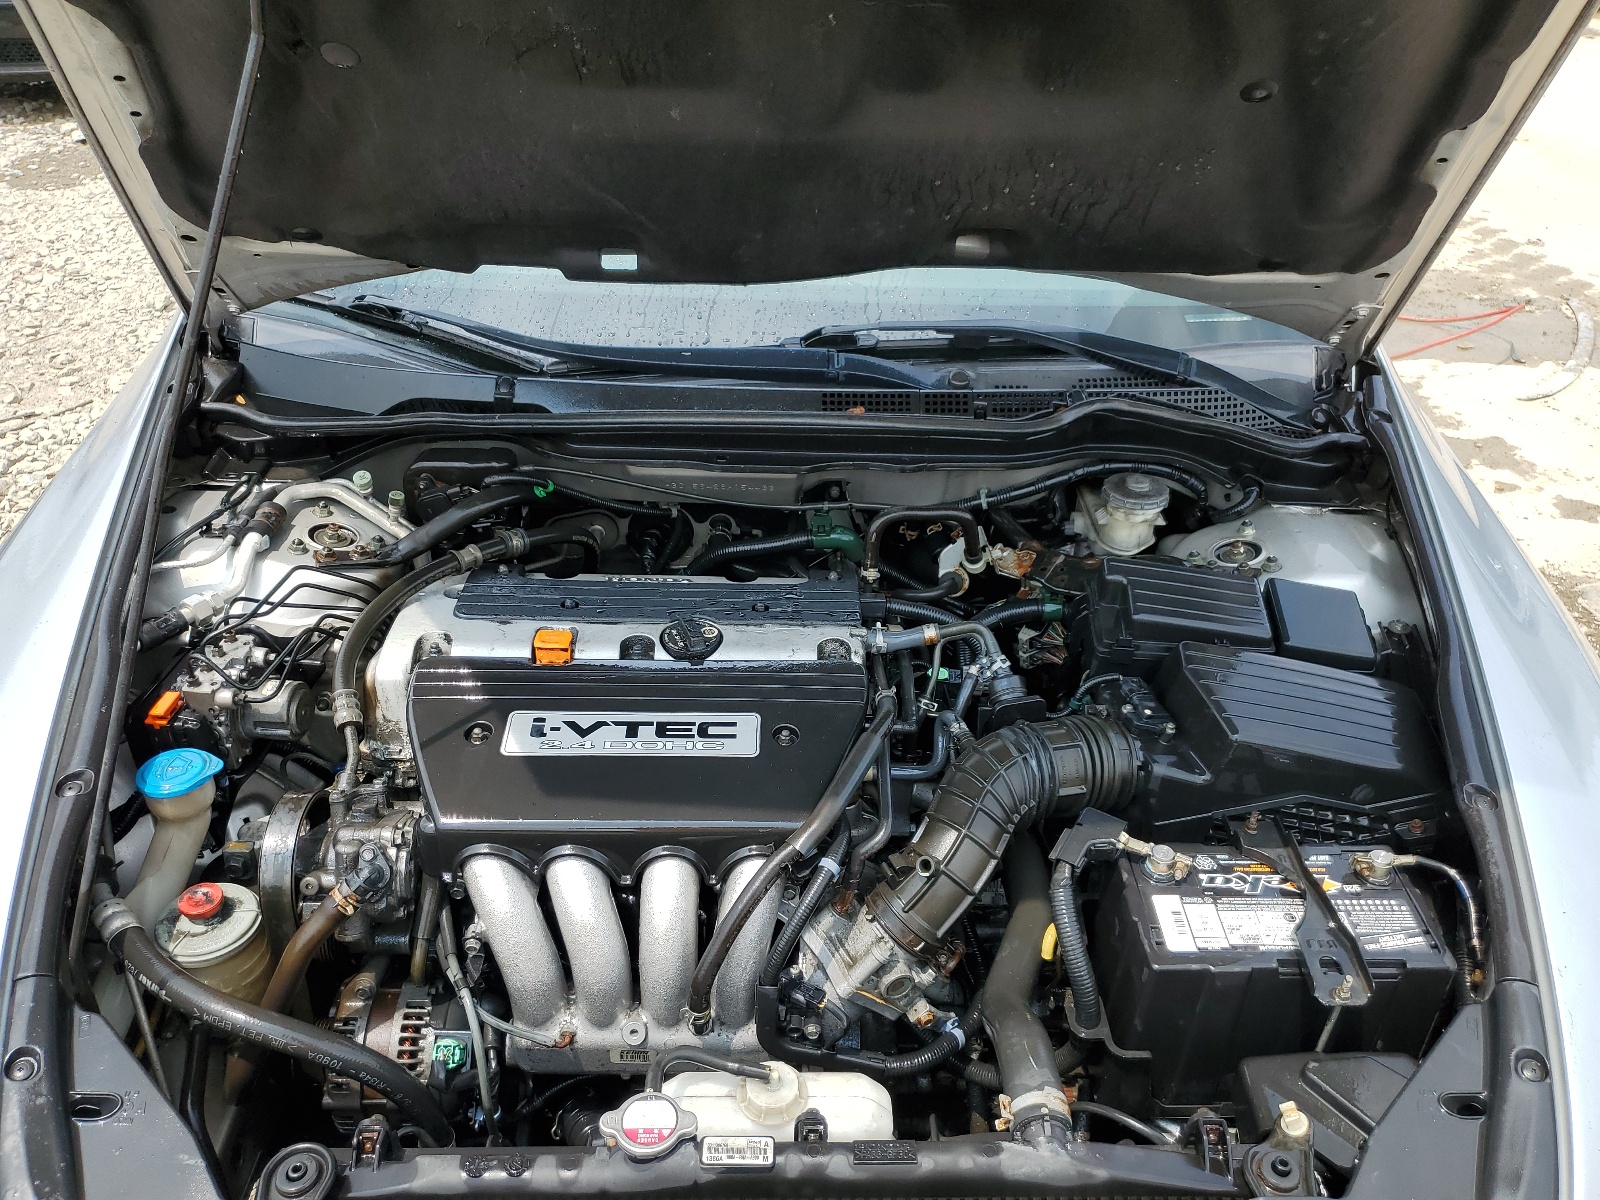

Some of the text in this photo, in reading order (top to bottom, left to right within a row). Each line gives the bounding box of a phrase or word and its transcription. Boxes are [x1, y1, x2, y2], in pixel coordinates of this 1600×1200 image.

[529, 717, 738, 740] i-VTEC
[539, 740, 726, 751] 2.4 DOHC
